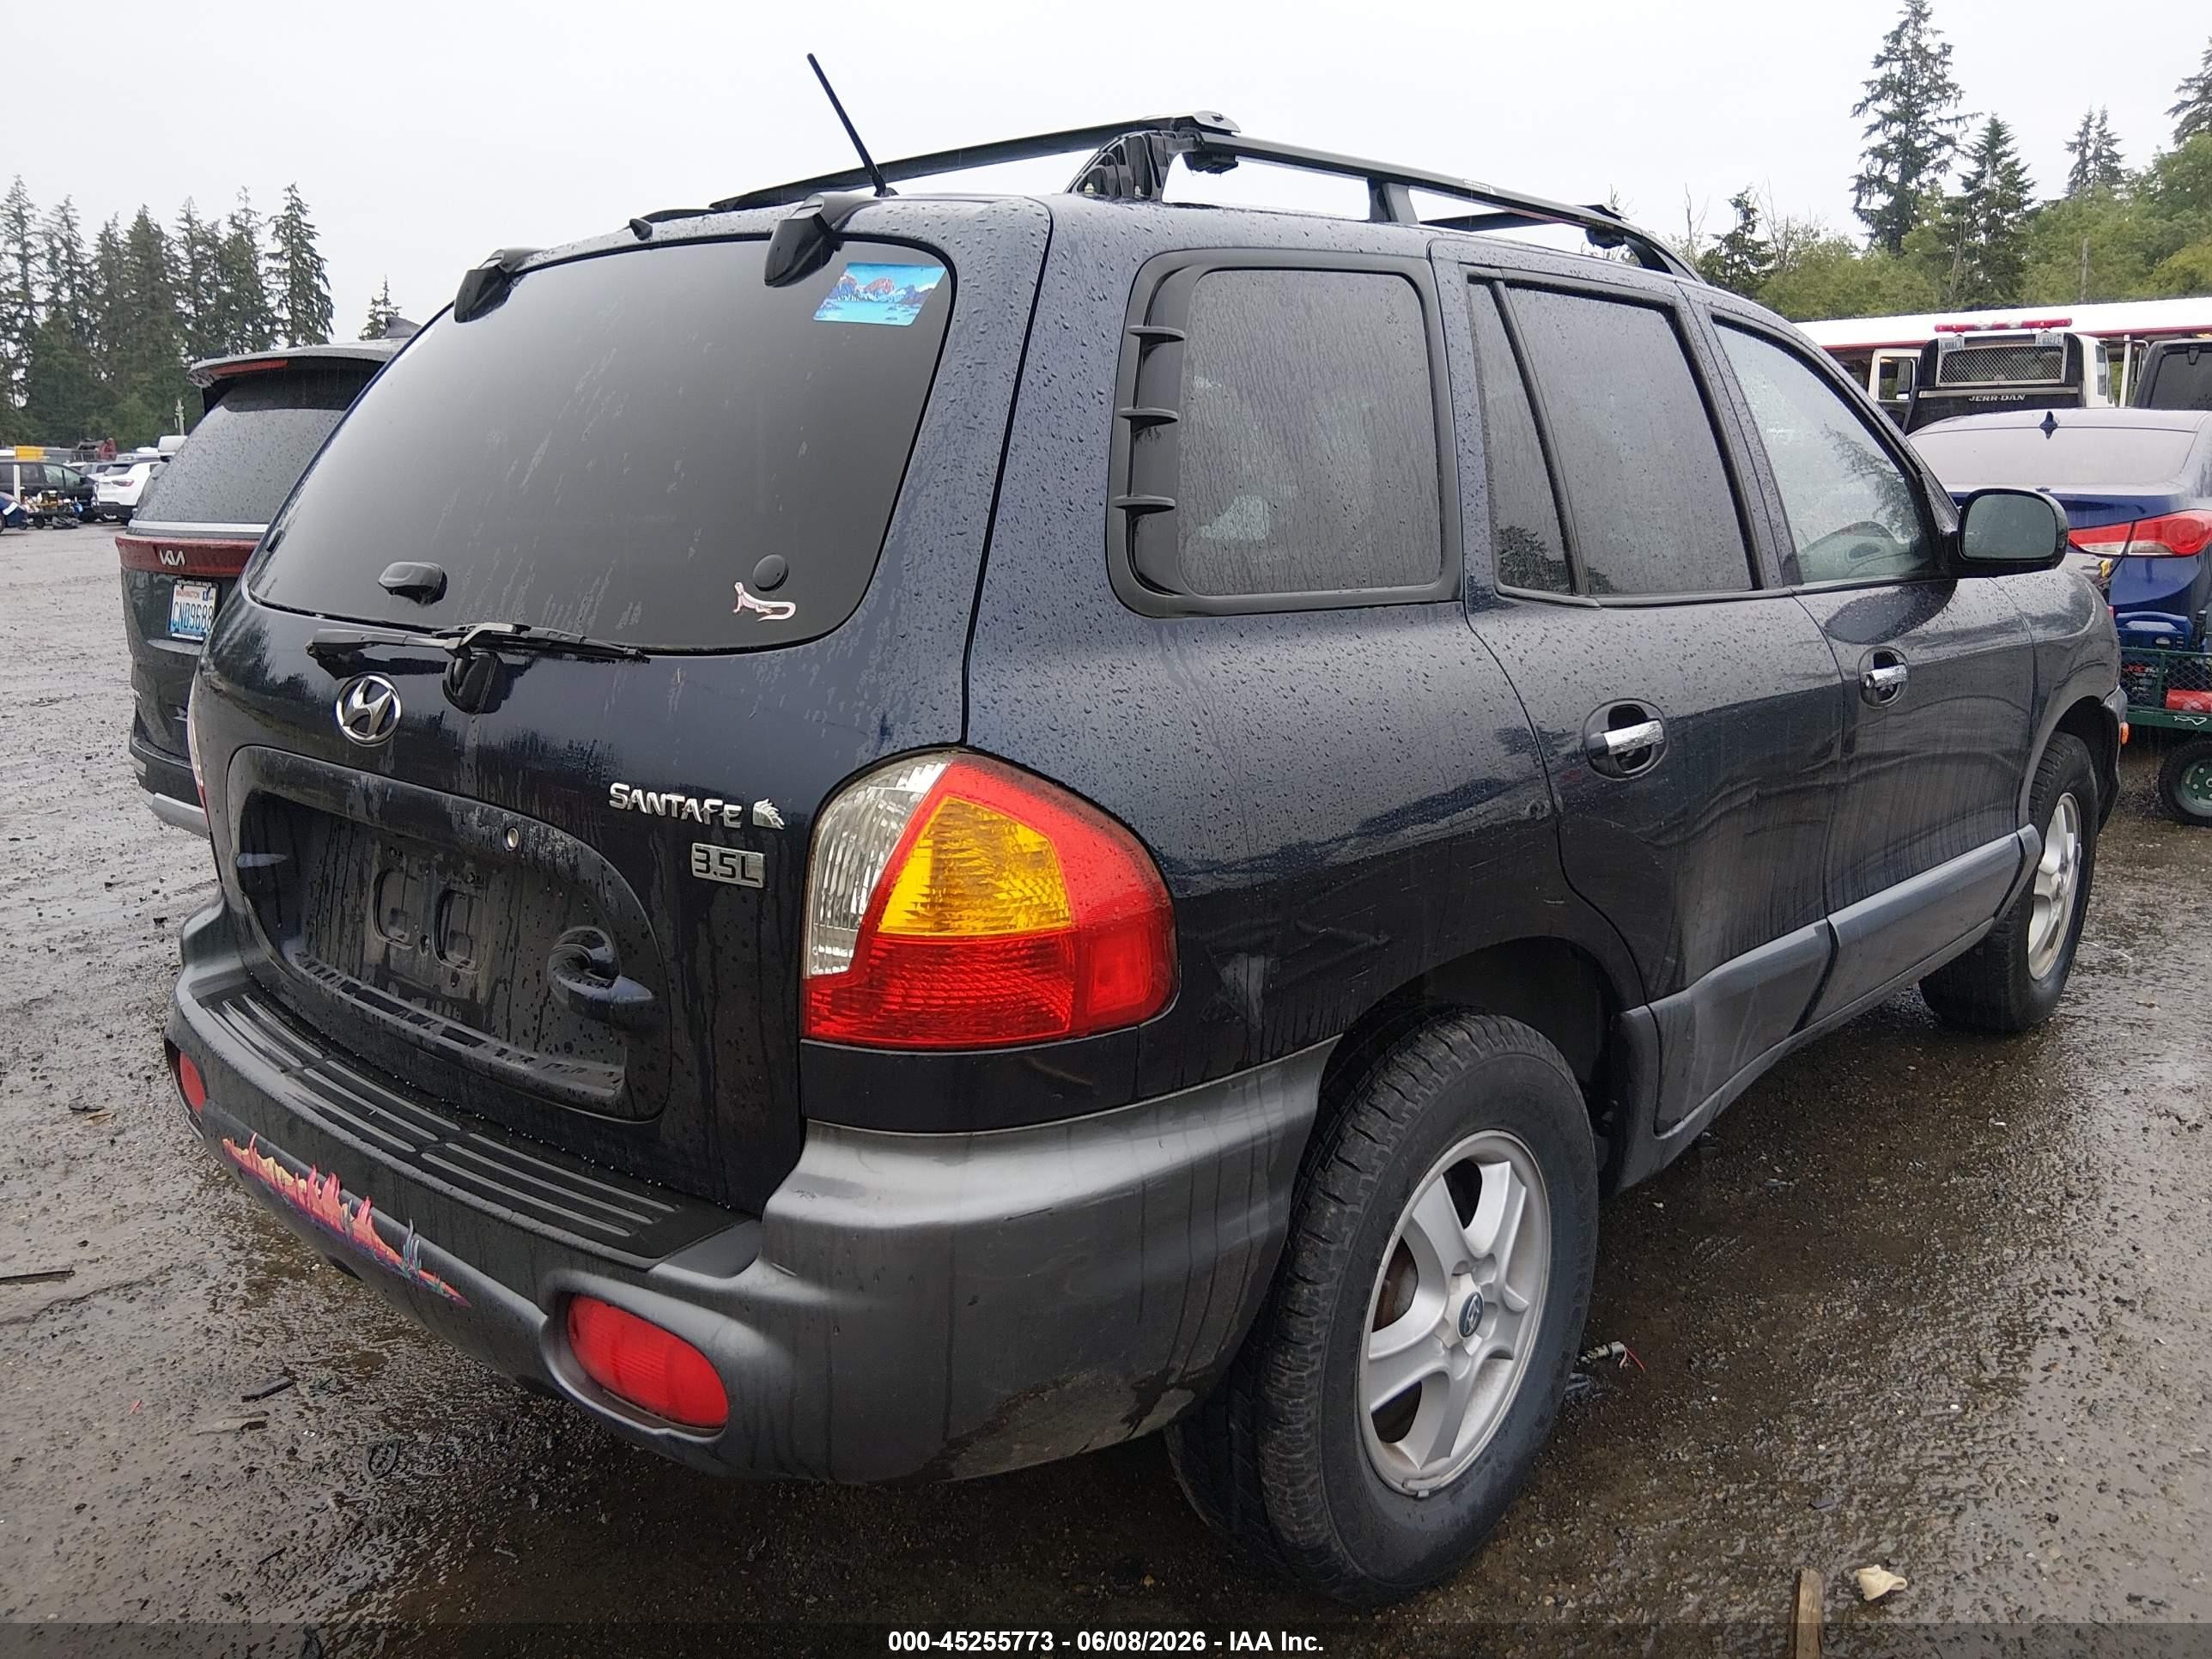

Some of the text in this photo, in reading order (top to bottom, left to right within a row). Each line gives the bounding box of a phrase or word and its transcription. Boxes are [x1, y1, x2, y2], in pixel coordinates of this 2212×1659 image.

[160, 550, 185, 567] KIA
[172, 601, 214, 632] CND9688
[694, 848, 760, 883] 3.5L
